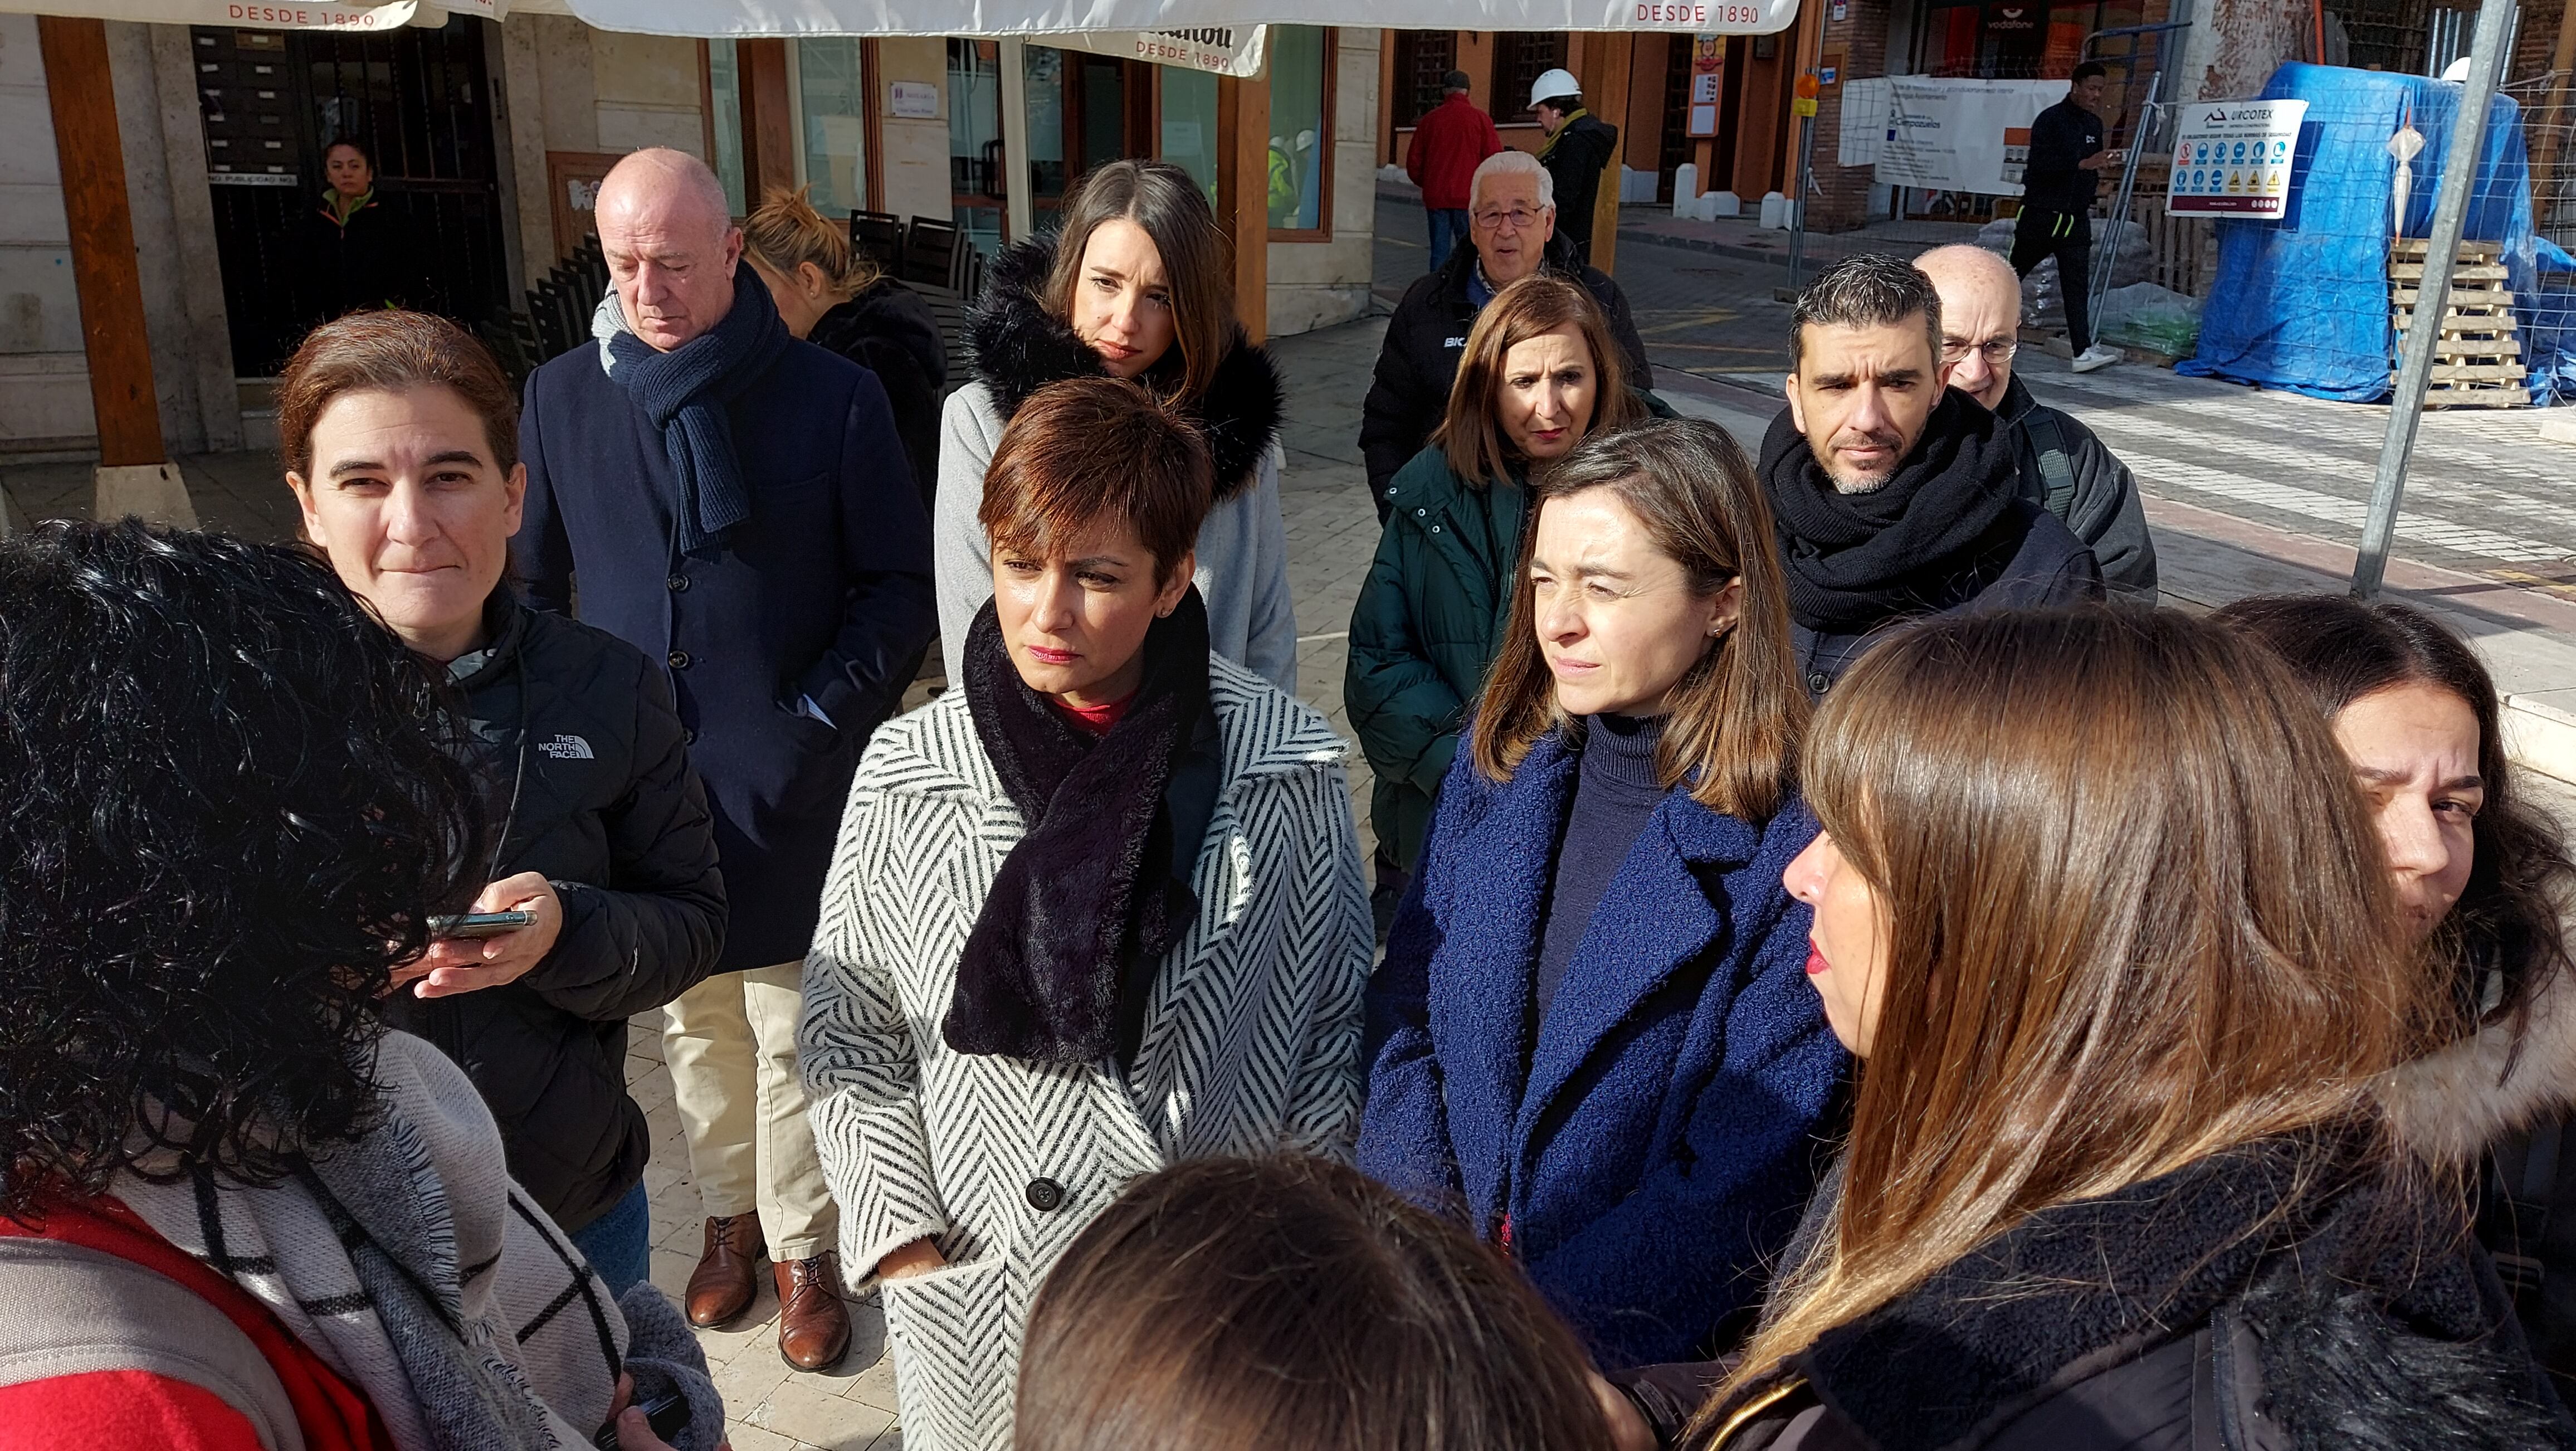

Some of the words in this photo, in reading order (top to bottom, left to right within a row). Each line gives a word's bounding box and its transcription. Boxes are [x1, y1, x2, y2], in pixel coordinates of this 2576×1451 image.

[230, 5, 308, 23] DESDE
[320, 12, 374, 26] 1890
[1637, 4, 1705, 22] DESDE
[1718, 5, 1758, 23] 1890
[1988, 20, 2033, 29] vodafone
[1136, 41, 1187, 60] DESDE
[1196, 52, 1229, 68] 1890
[2231, 109, 2273, 120] URCOTEX
[554, 734, 574, 743] THE
[538, 743, 575, 751] NORTH
